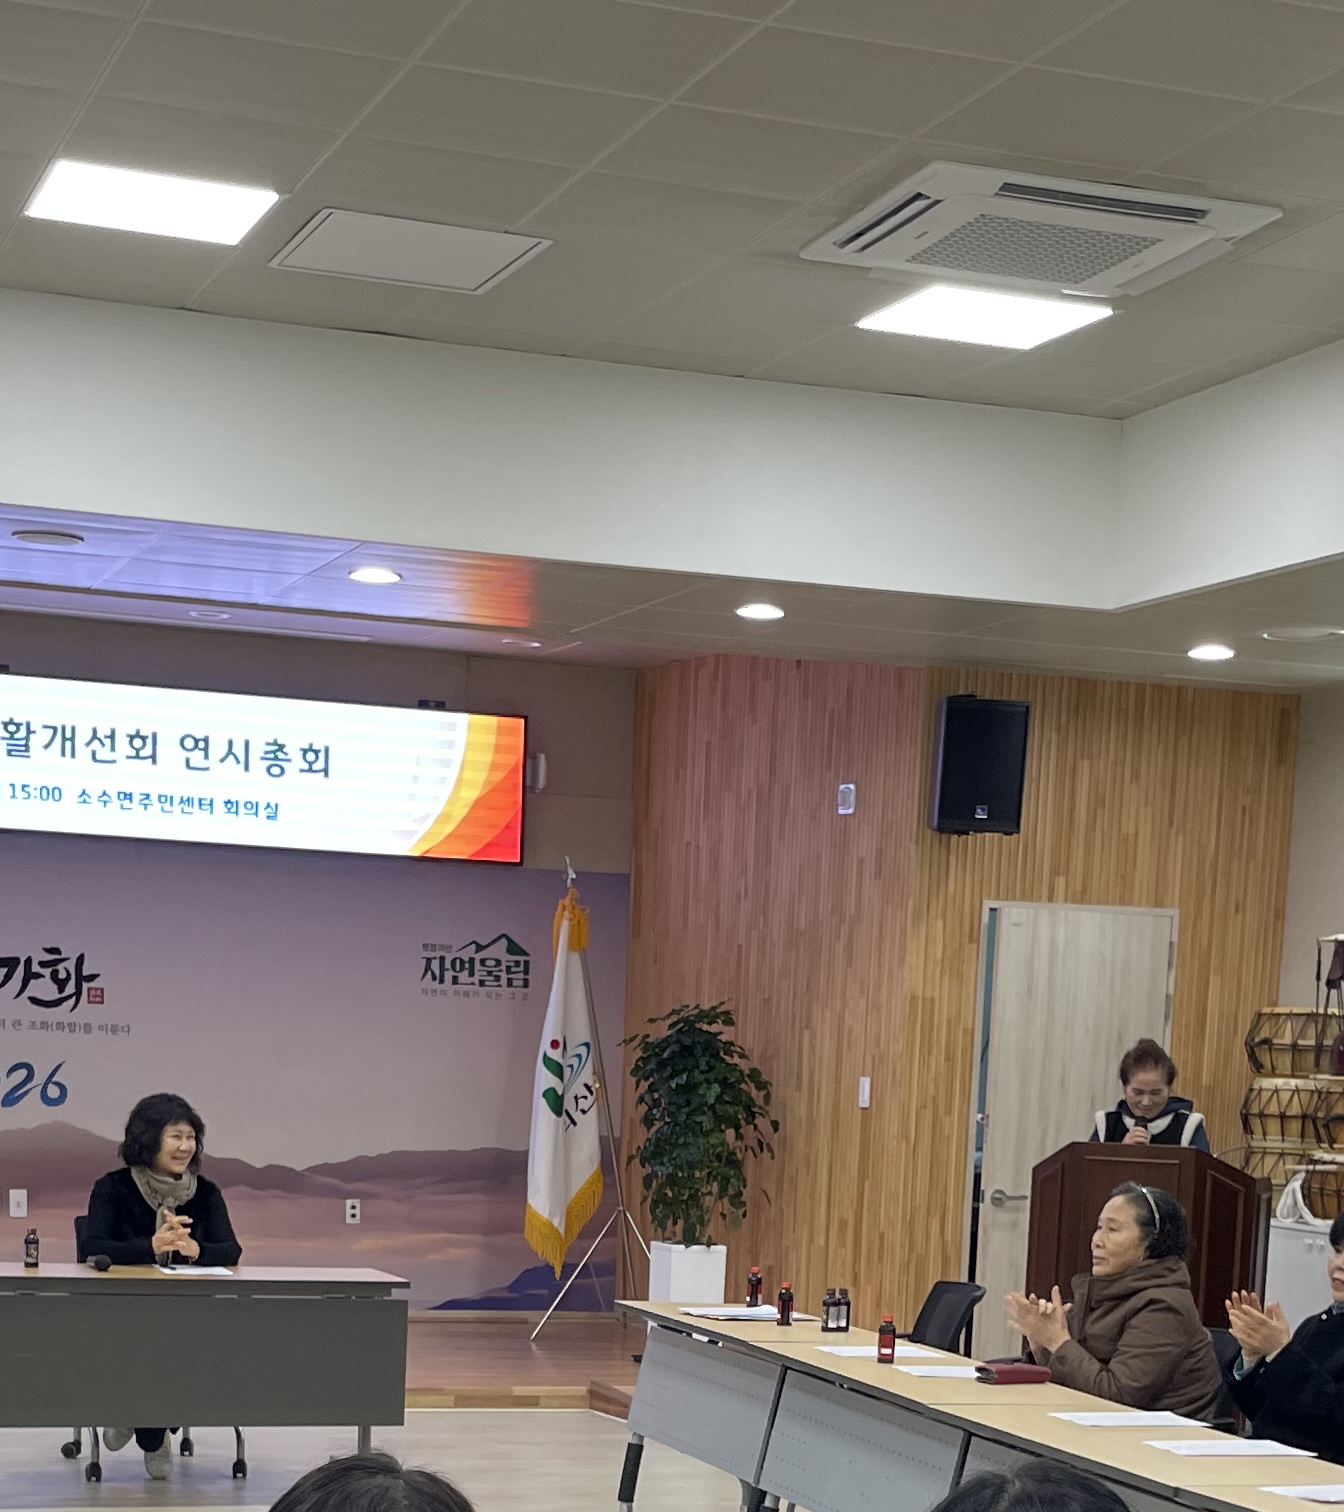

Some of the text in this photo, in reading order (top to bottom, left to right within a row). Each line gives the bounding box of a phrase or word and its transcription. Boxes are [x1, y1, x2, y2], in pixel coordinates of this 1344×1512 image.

[179, 732, 332, 779] 연시총회
[8, 783, 63, 803] 15:00
[76, 788, 215, 816] 소수면주민센터
[223, 797, 280, 821] 회의실
[420, 955, 531, 988] 자연울림
